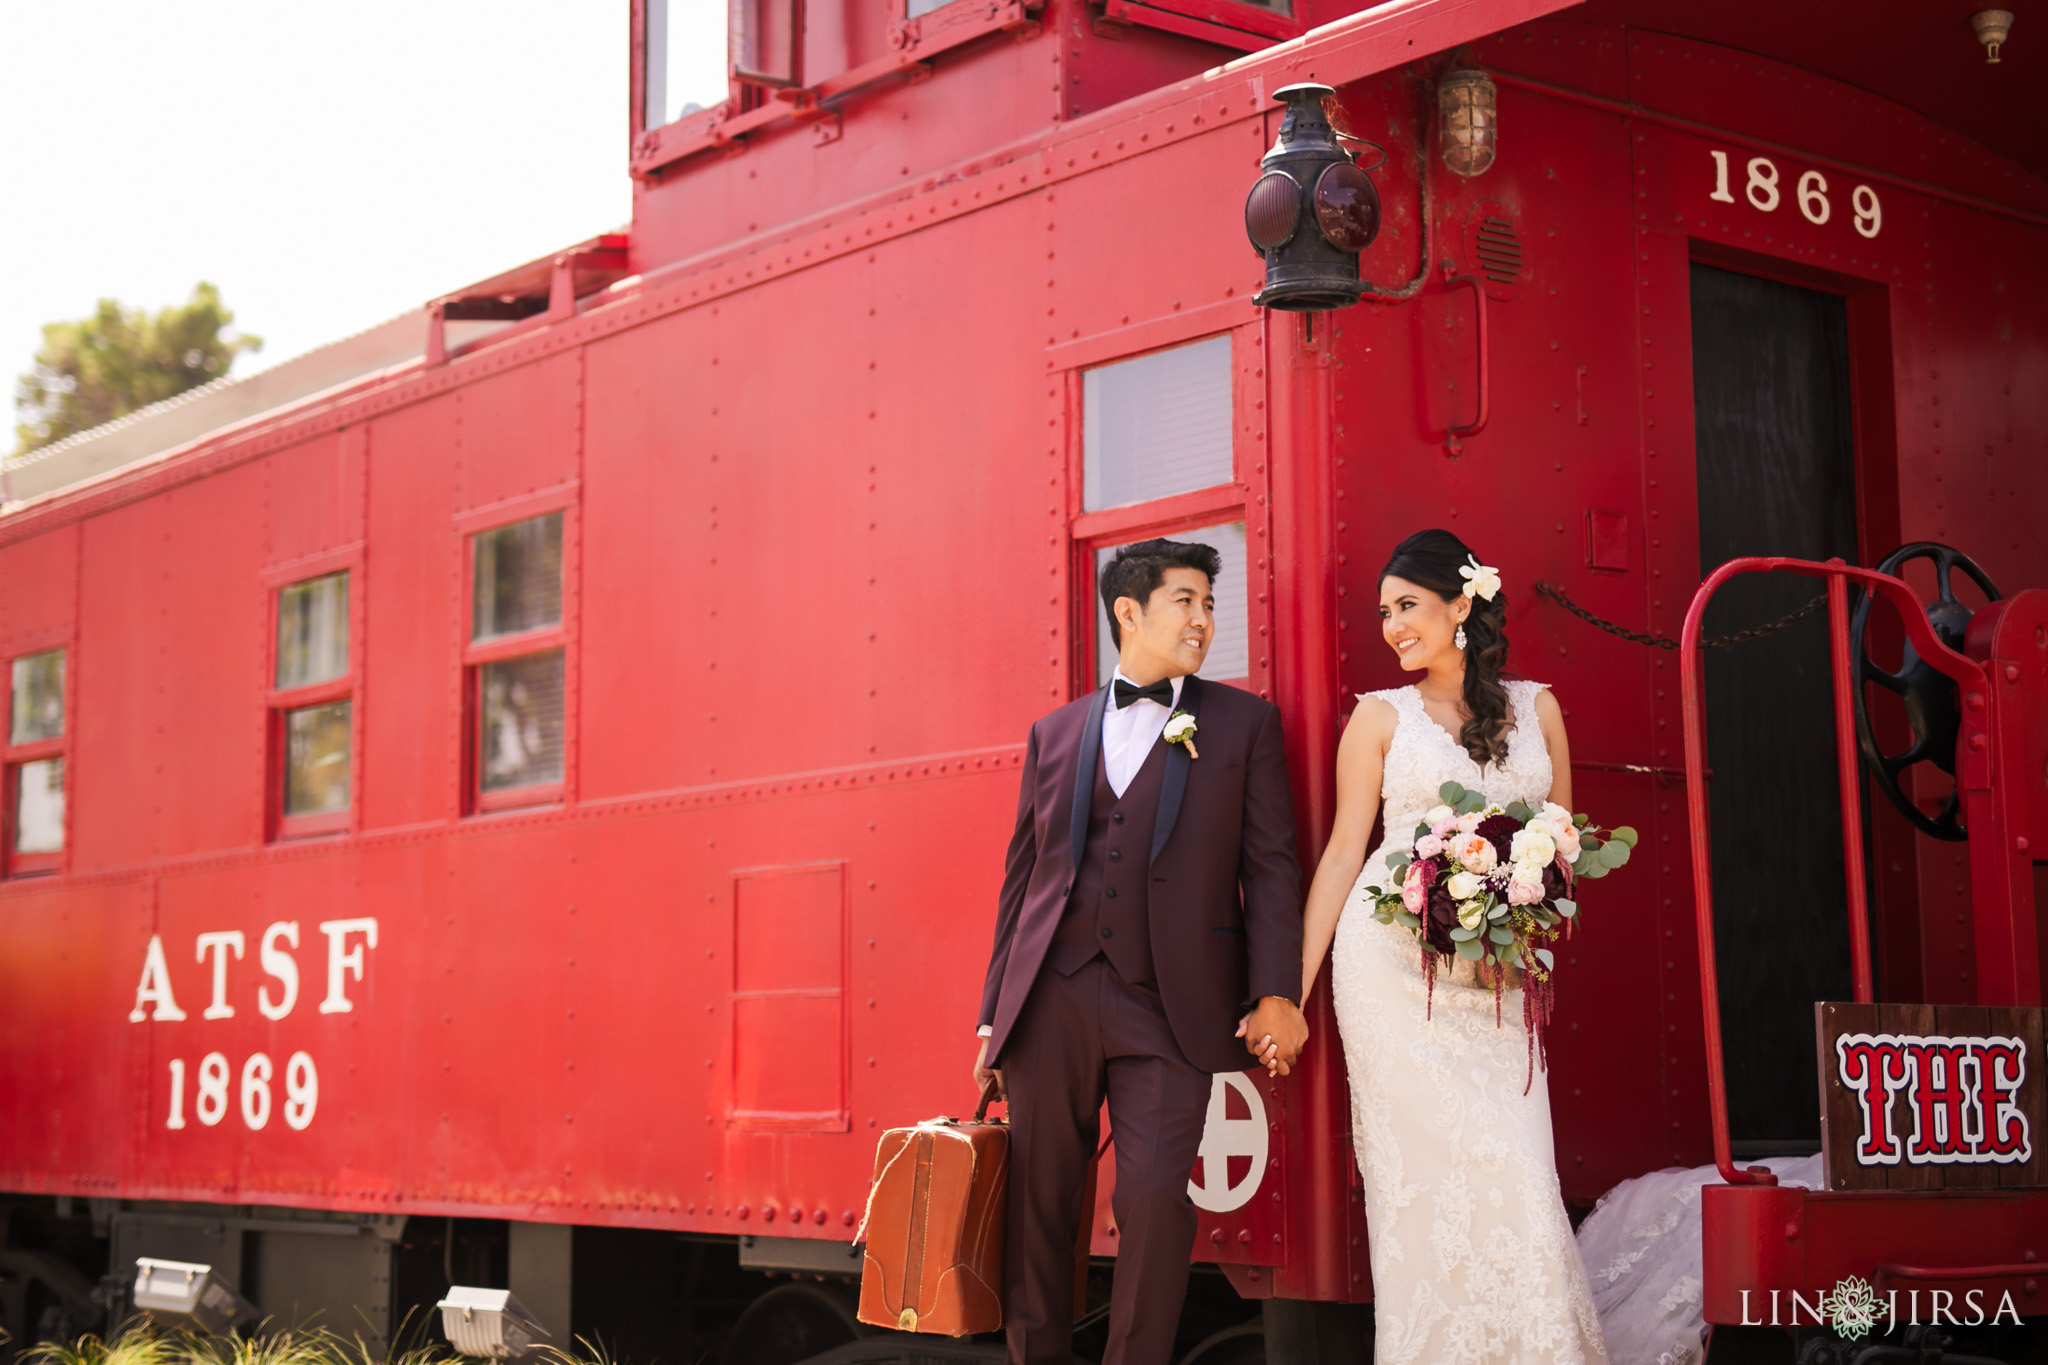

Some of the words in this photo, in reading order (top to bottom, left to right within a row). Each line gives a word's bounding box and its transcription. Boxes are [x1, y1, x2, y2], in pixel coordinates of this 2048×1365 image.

[1710, 150, 1881, 238] 1869
[129, 917, 378, 1023] ATSF
[166, 1051, 318, 1131] 1869
[1836, 1033, 2031, 1165] THE
